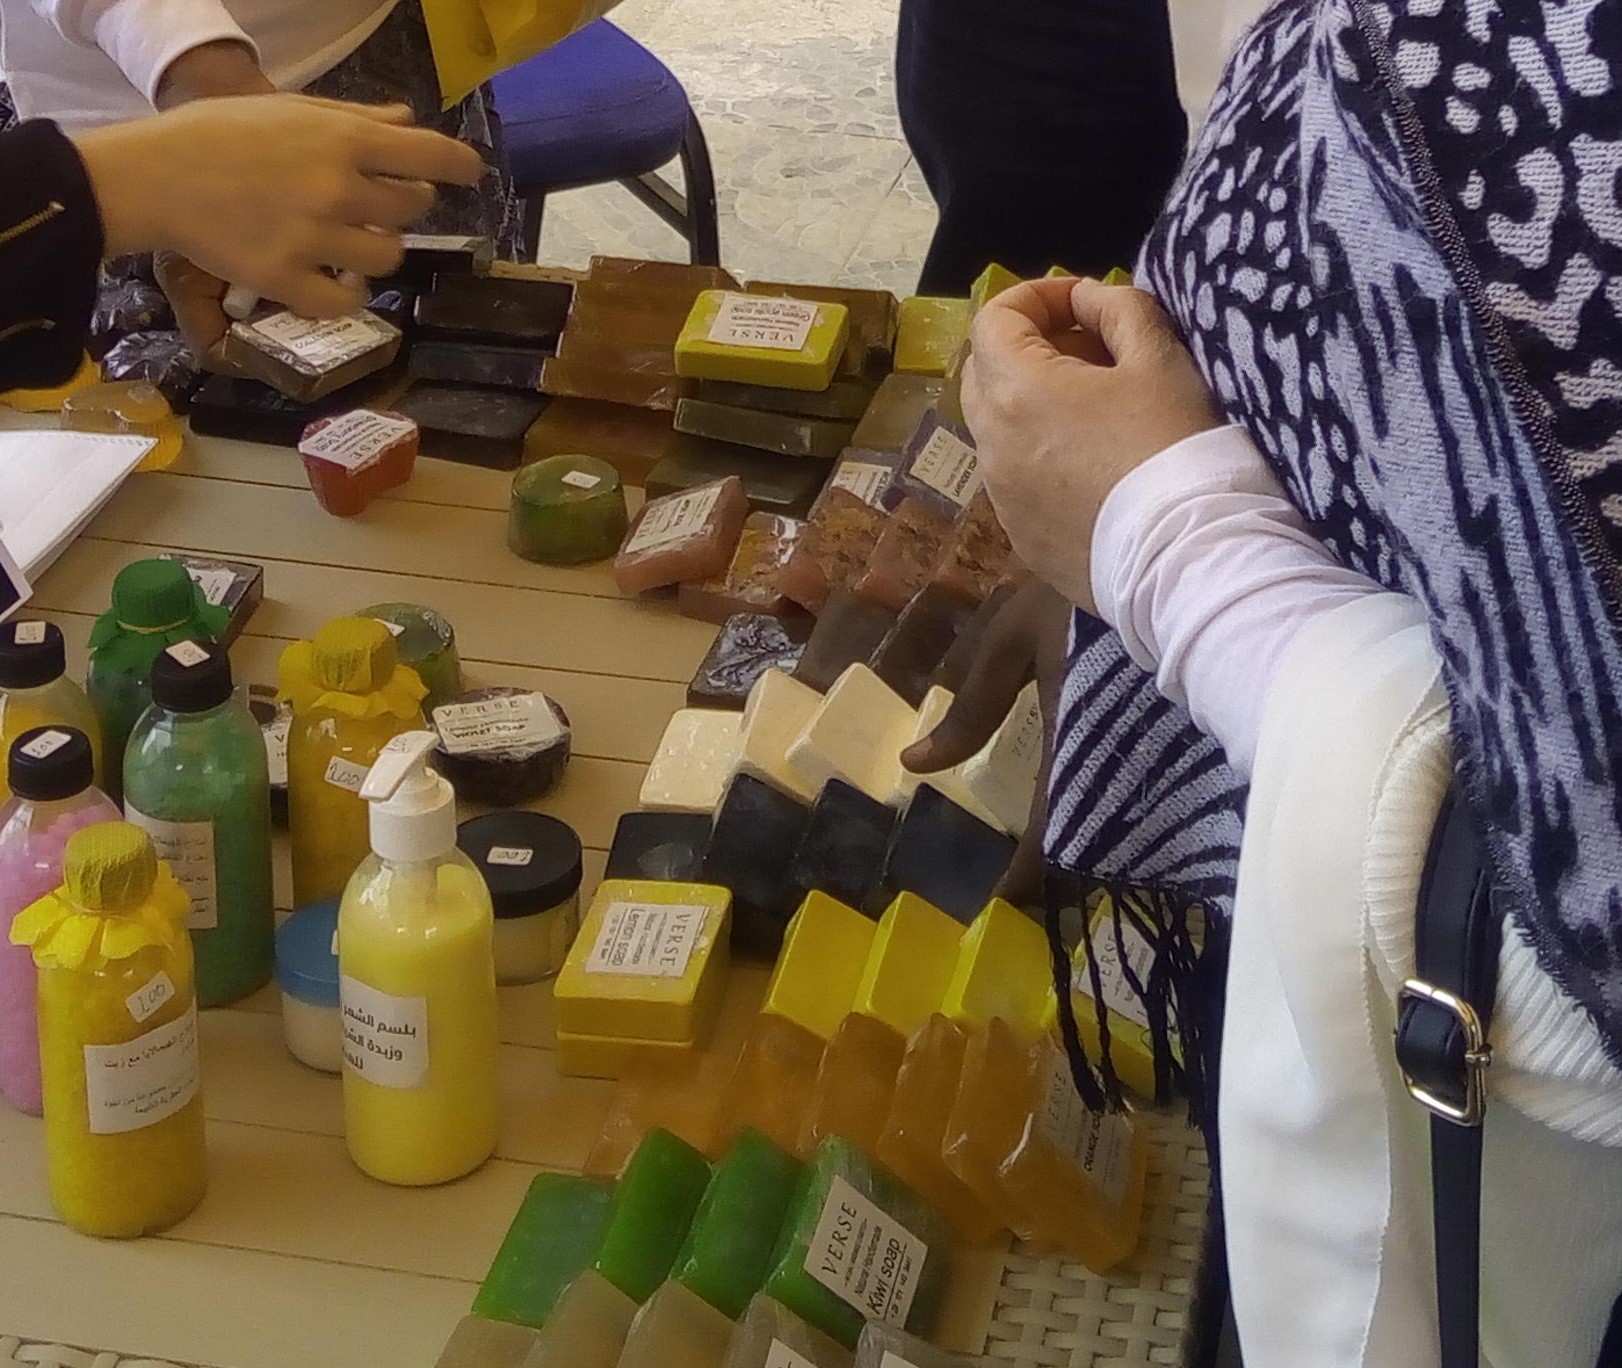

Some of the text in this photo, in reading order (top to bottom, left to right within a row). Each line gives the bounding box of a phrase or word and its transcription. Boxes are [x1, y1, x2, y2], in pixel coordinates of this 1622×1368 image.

[441, 700, 520, 718] VERSE
[659, 913, 691, 967] VERSE
[377, 1022, 416, 1039] بلسم
[366, 1039, 403, 1062] وزبدة
[821, 1201, 858, 1276] VERSE
[866, 1237, 903, 1316] Kiwi soap
